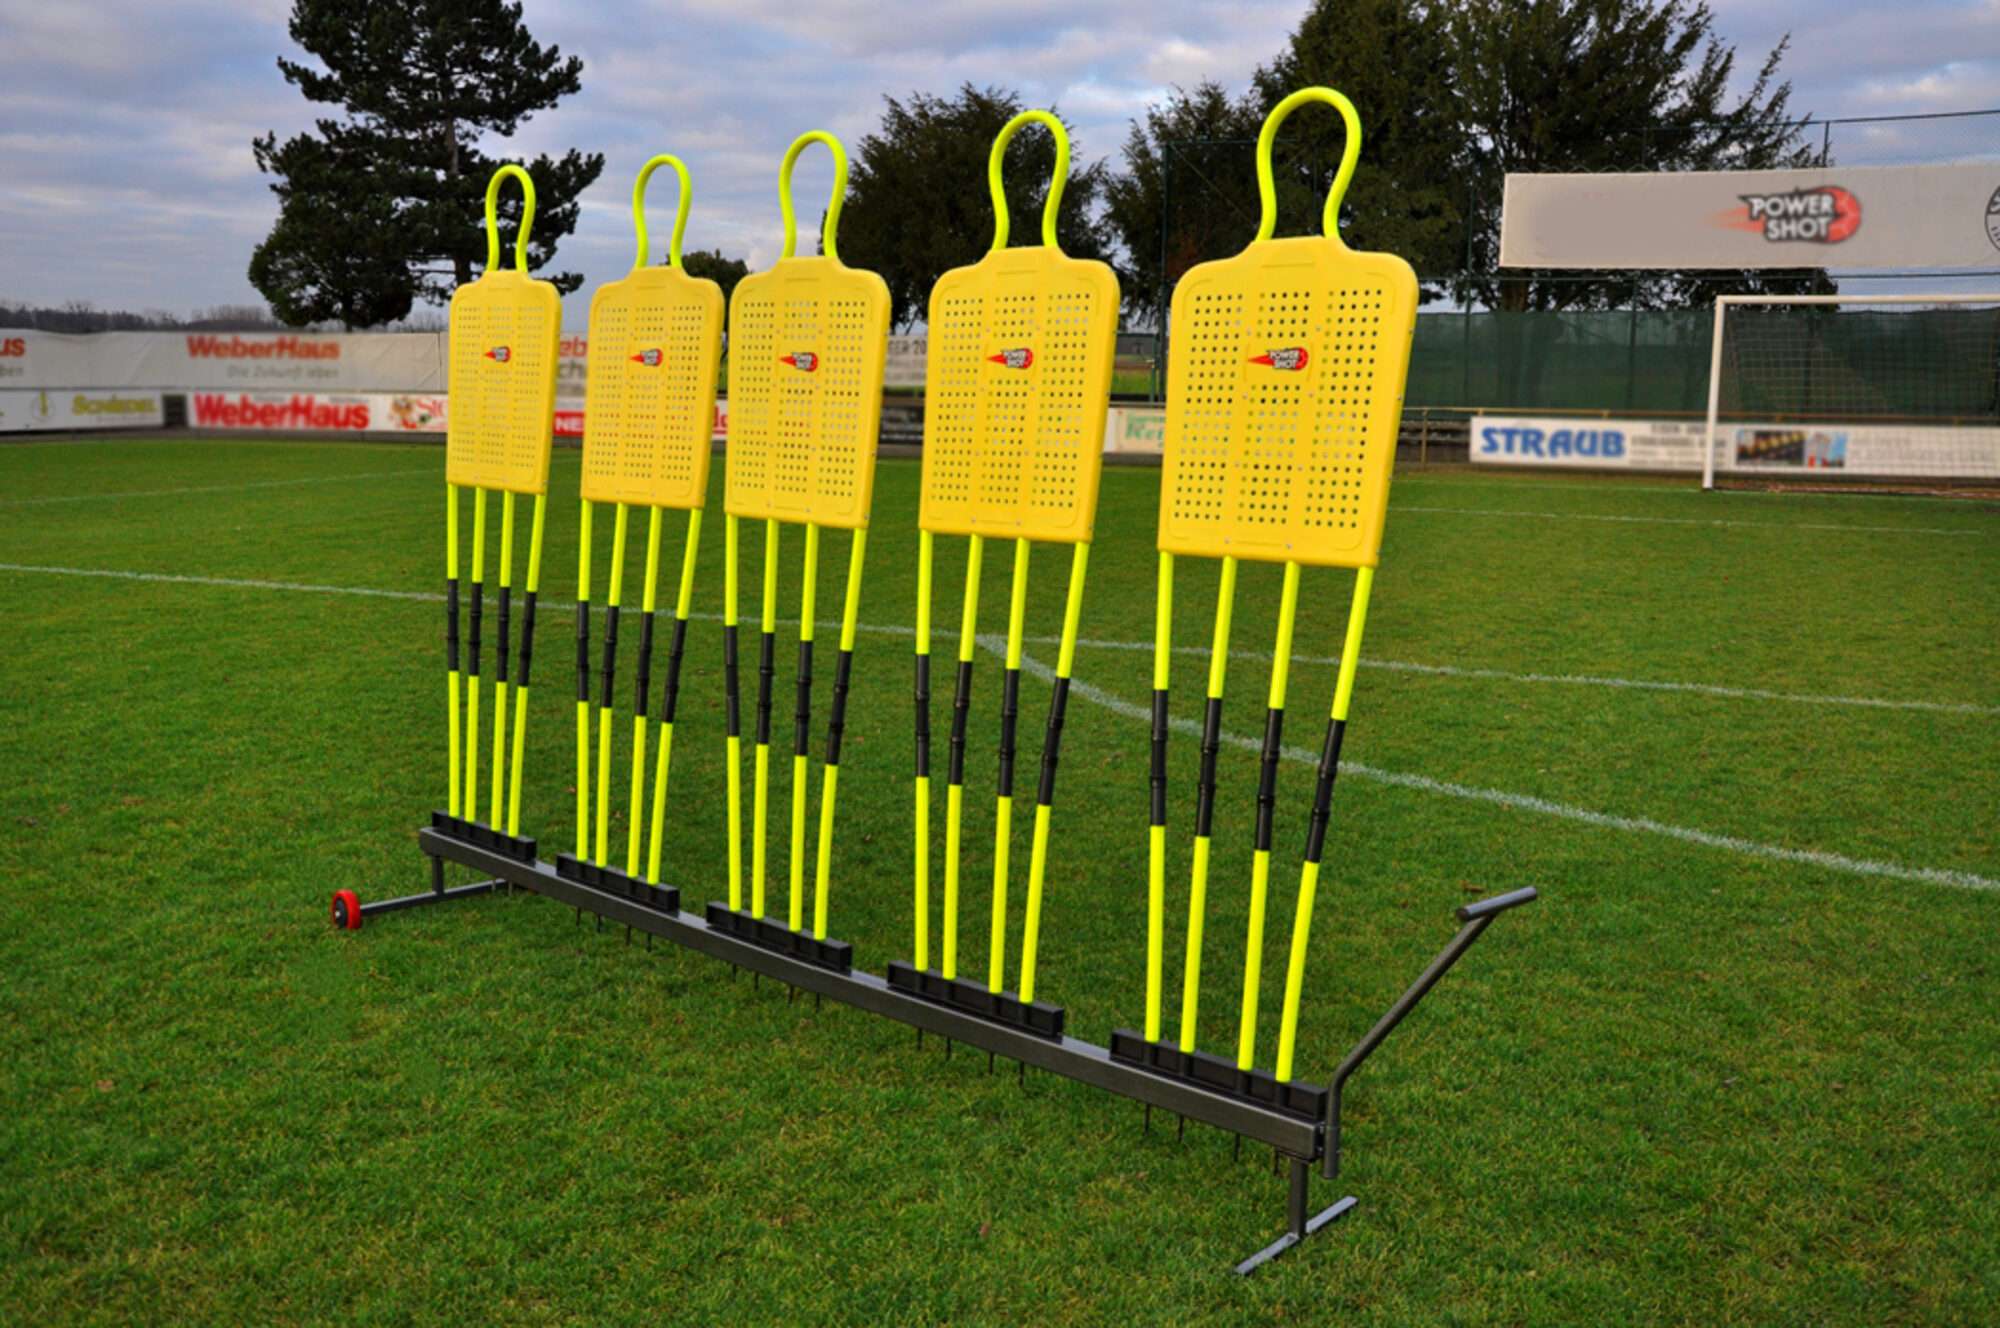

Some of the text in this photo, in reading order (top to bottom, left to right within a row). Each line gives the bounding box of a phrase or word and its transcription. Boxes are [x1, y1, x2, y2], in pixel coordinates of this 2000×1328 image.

[1749, 193, 1834, 218] POWER
[1767, 216, 1829, 239] SHOT
[187, 335, 340, 359] WeberHaus
[194, 393, 368, 431] WeberHaus
[1481, 427, 1625, 458] STRAUB
